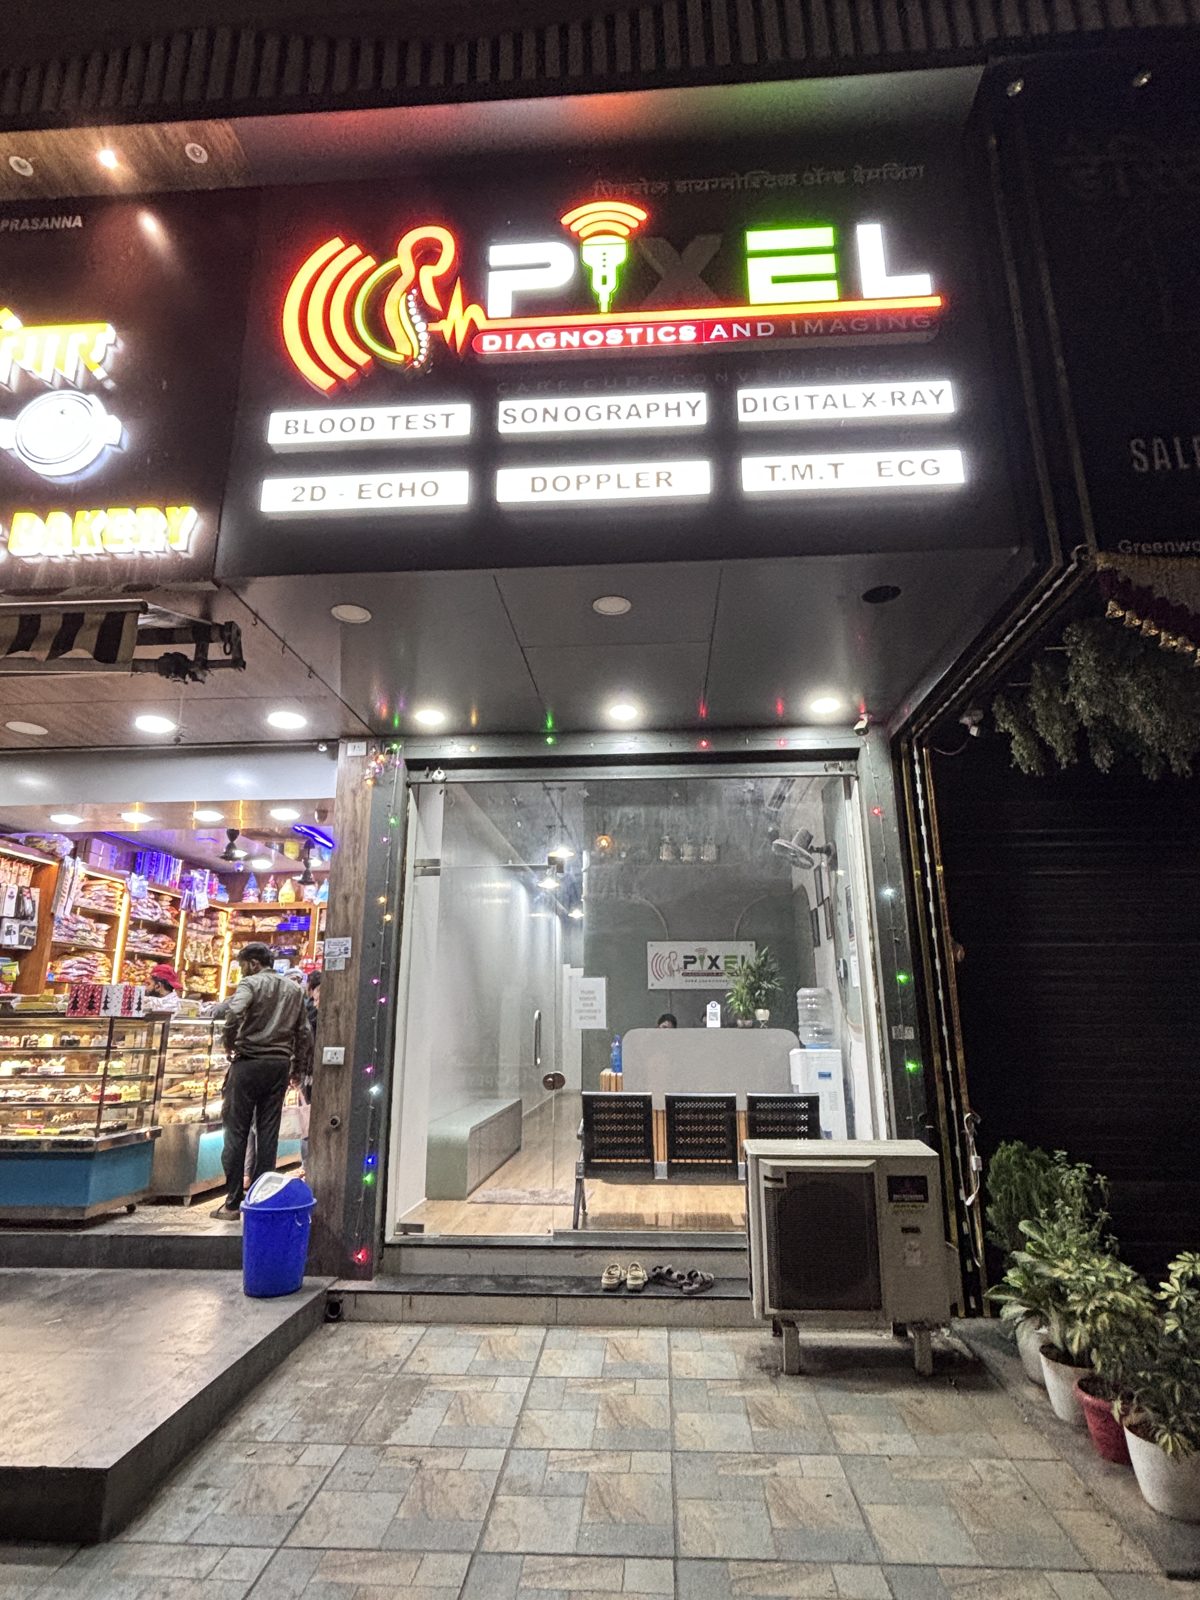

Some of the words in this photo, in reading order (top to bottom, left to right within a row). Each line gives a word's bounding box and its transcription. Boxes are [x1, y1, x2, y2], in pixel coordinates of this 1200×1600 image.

[0, 215, 83, 232] PRASANNA
[487, 202, 934, 319] PIXEL
[482, 324, 698, 352] DIAGNOSTICS
[709, 320, 775, 341] AND
[790, 313, 932, 336] IMAGING
[284, 415, 375, 435] BLOOD
[387, 413, 455, 431] TEST
[502, 400, 702, 425] SONOGRAPHY
[530, 471, 673, 493] DOPPLER
[764, 462, 845, 482] T.M.T
[876, 458, 941, 478] ECG
[291, 485, 327, 503] 2D
[357, 480, 439, 500] ECHO
[8, 506, 197, 557] BAKERY
